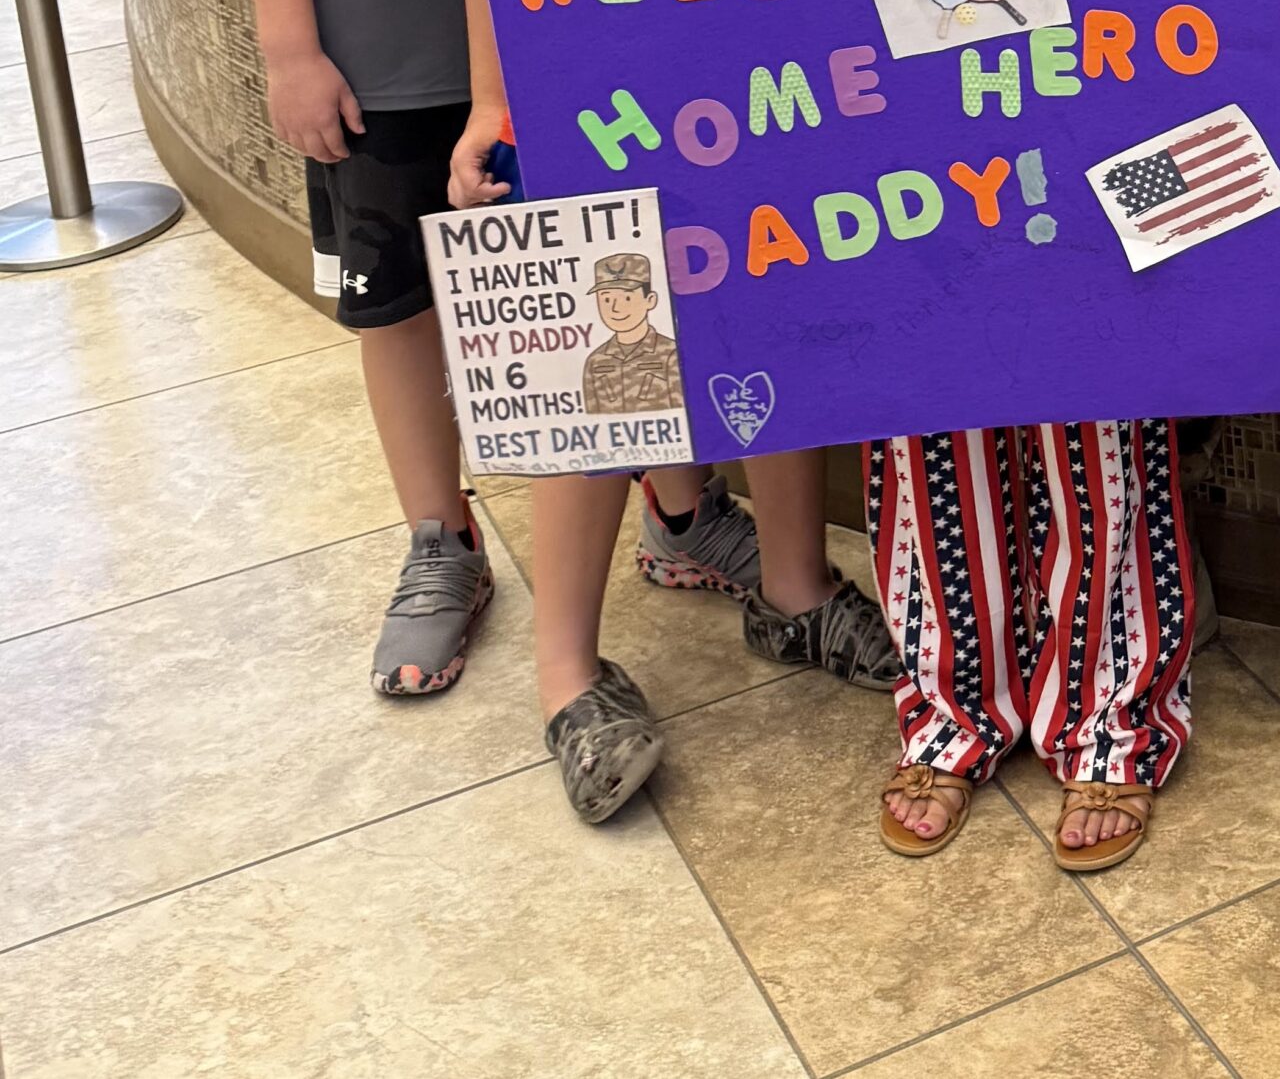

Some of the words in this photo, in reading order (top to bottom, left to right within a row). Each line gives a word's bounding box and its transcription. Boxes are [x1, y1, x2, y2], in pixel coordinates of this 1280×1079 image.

[577, 45, 887, 171] HOME
[960, 4, 1219, 118] HERO
[438, 209, 563, 259] MOVE
[581, 198, 641, 244] IT!
[665, 148, 1058, 296] DADDY!
[447, 269, 463, 295] I
[470, 256, 581, 293] HAVEN'T
[453, 292, 576, 328] HUGGED
[459, 332, 500, 360] MY
[509, 323, 594, 355] DADDY
[466, 366, 495, 393] IN
[506, 362, 528, 390] 6
[470, 390, 584, 424] MONTHS!
[475, 430, 541, 460] BEST
[551, 424, 600, 454] DAY
[608, 417, 683, 448] EVER!
